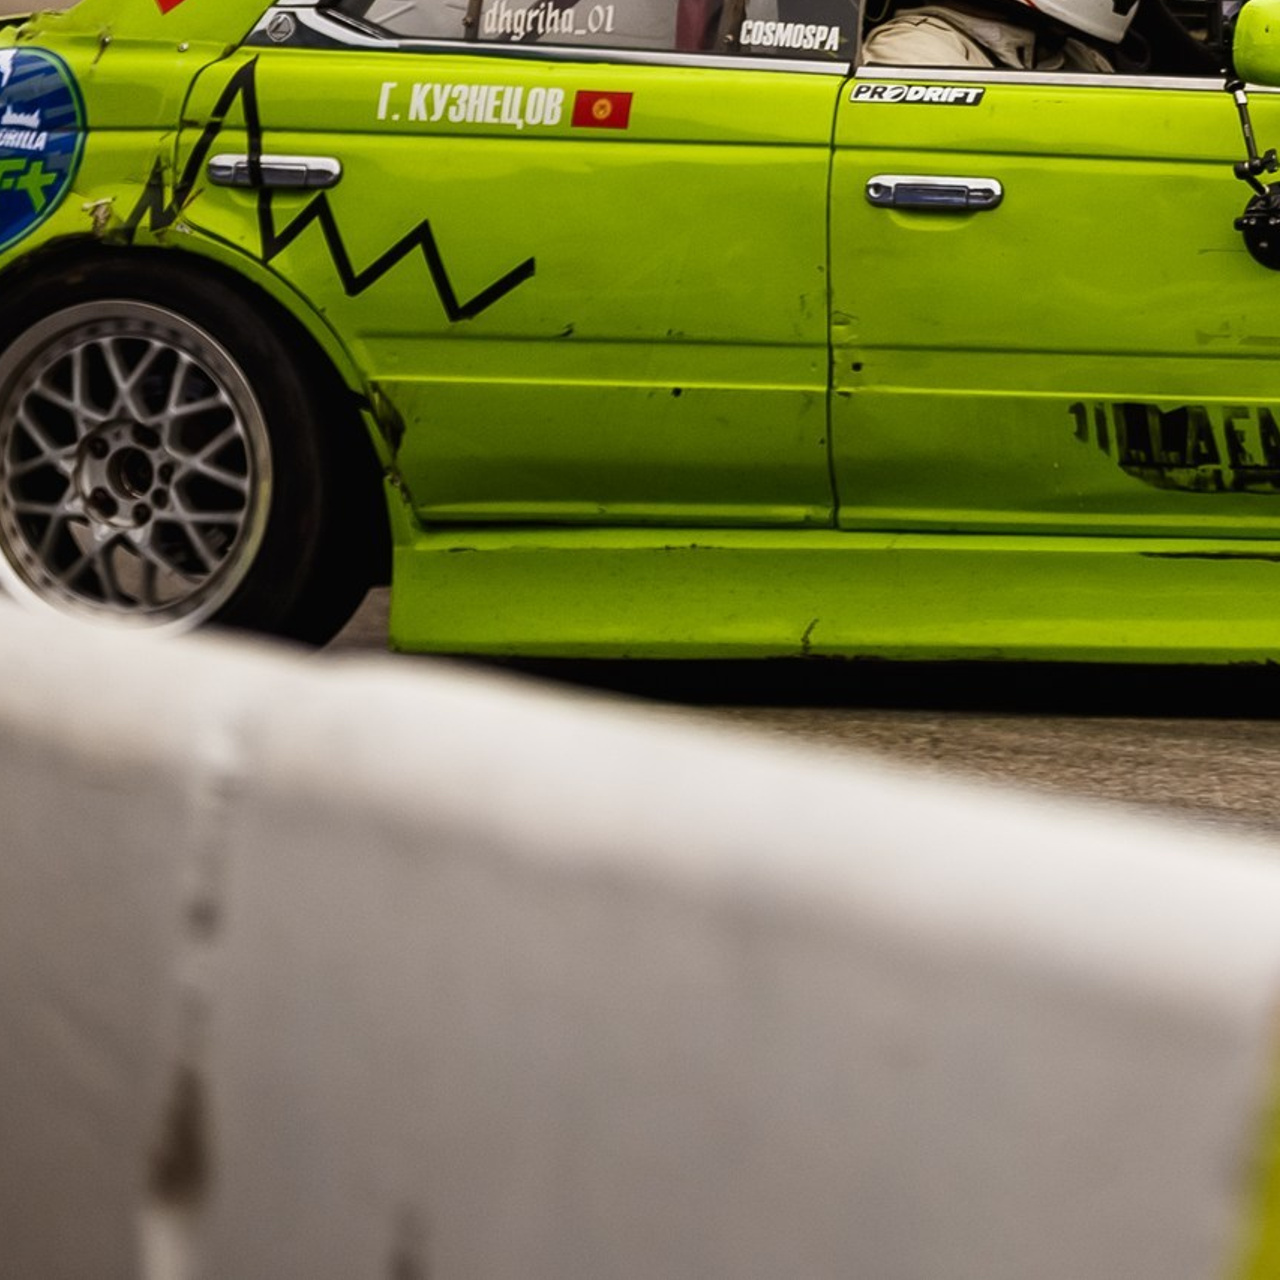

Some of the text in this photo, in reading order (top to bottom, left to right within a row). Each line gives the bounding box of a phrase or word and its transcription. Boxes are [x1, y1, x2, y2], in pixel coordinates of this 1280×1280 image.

[739, 20, 841, 51] COSMOSPA
[377, 82, 565, 130] Г. КУЗНЕЦОВ
